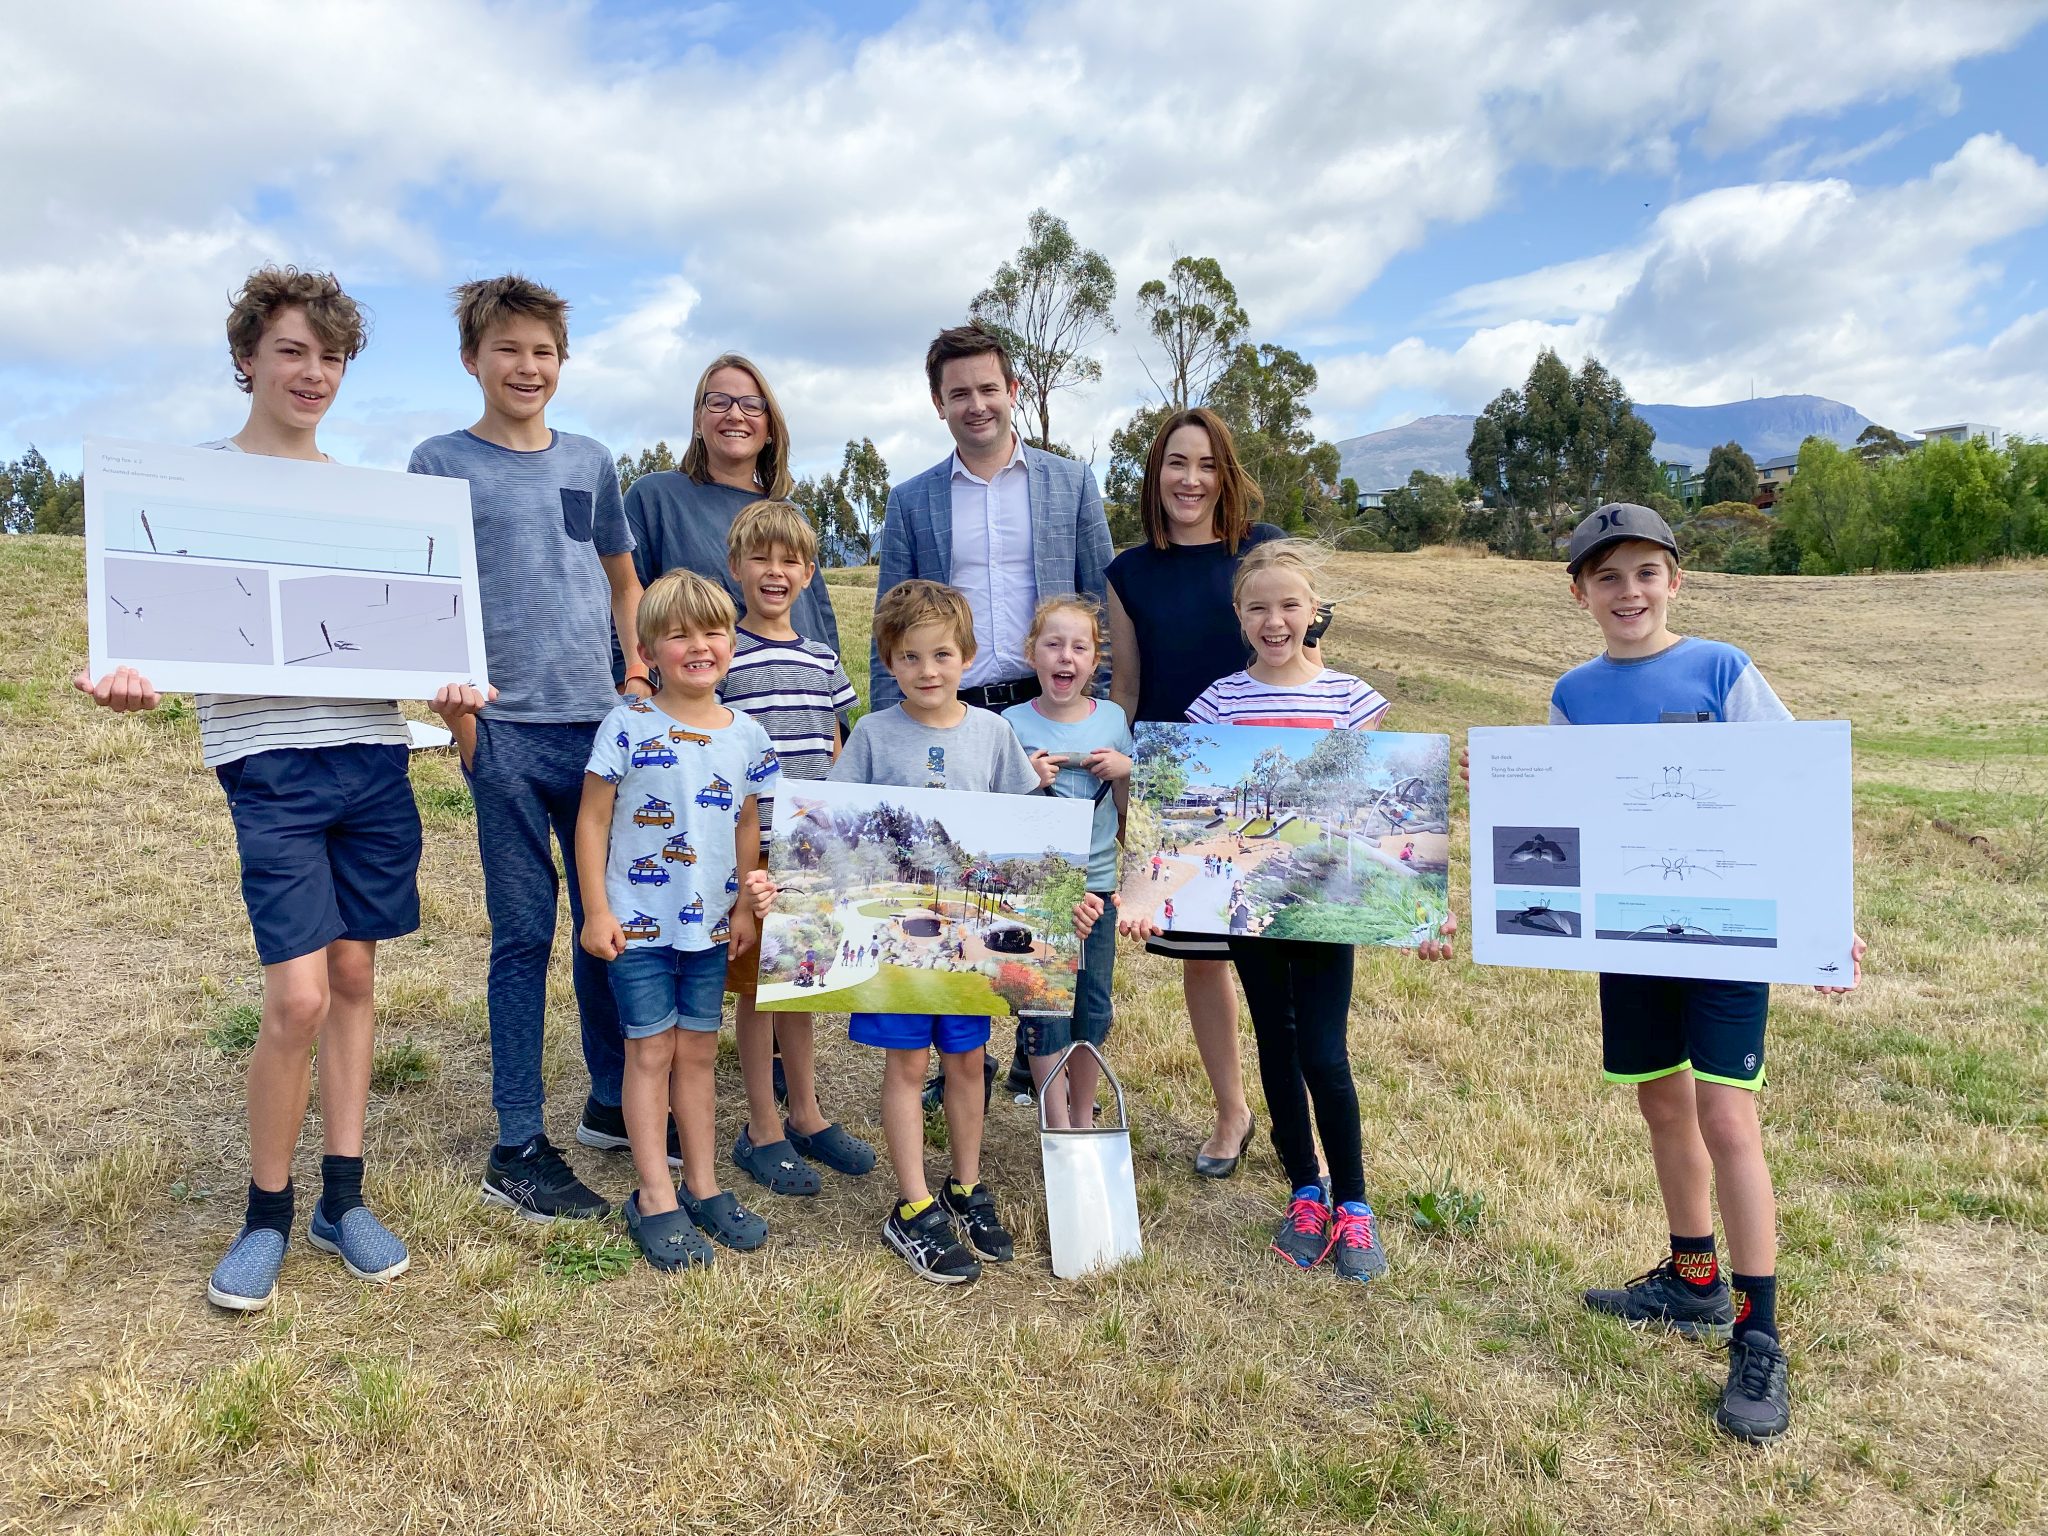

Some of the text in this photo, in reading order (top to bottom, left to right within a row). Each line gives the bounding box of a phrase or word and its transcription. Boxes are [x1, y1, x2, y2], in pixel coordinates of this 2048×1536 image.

[102, 454, 120, 463] Flying
[131, 470, 159, 479] elements
[1675, 1252, 1713, 1265] SANTA
[1680, 1266, 1712, 1278] CRUZ
